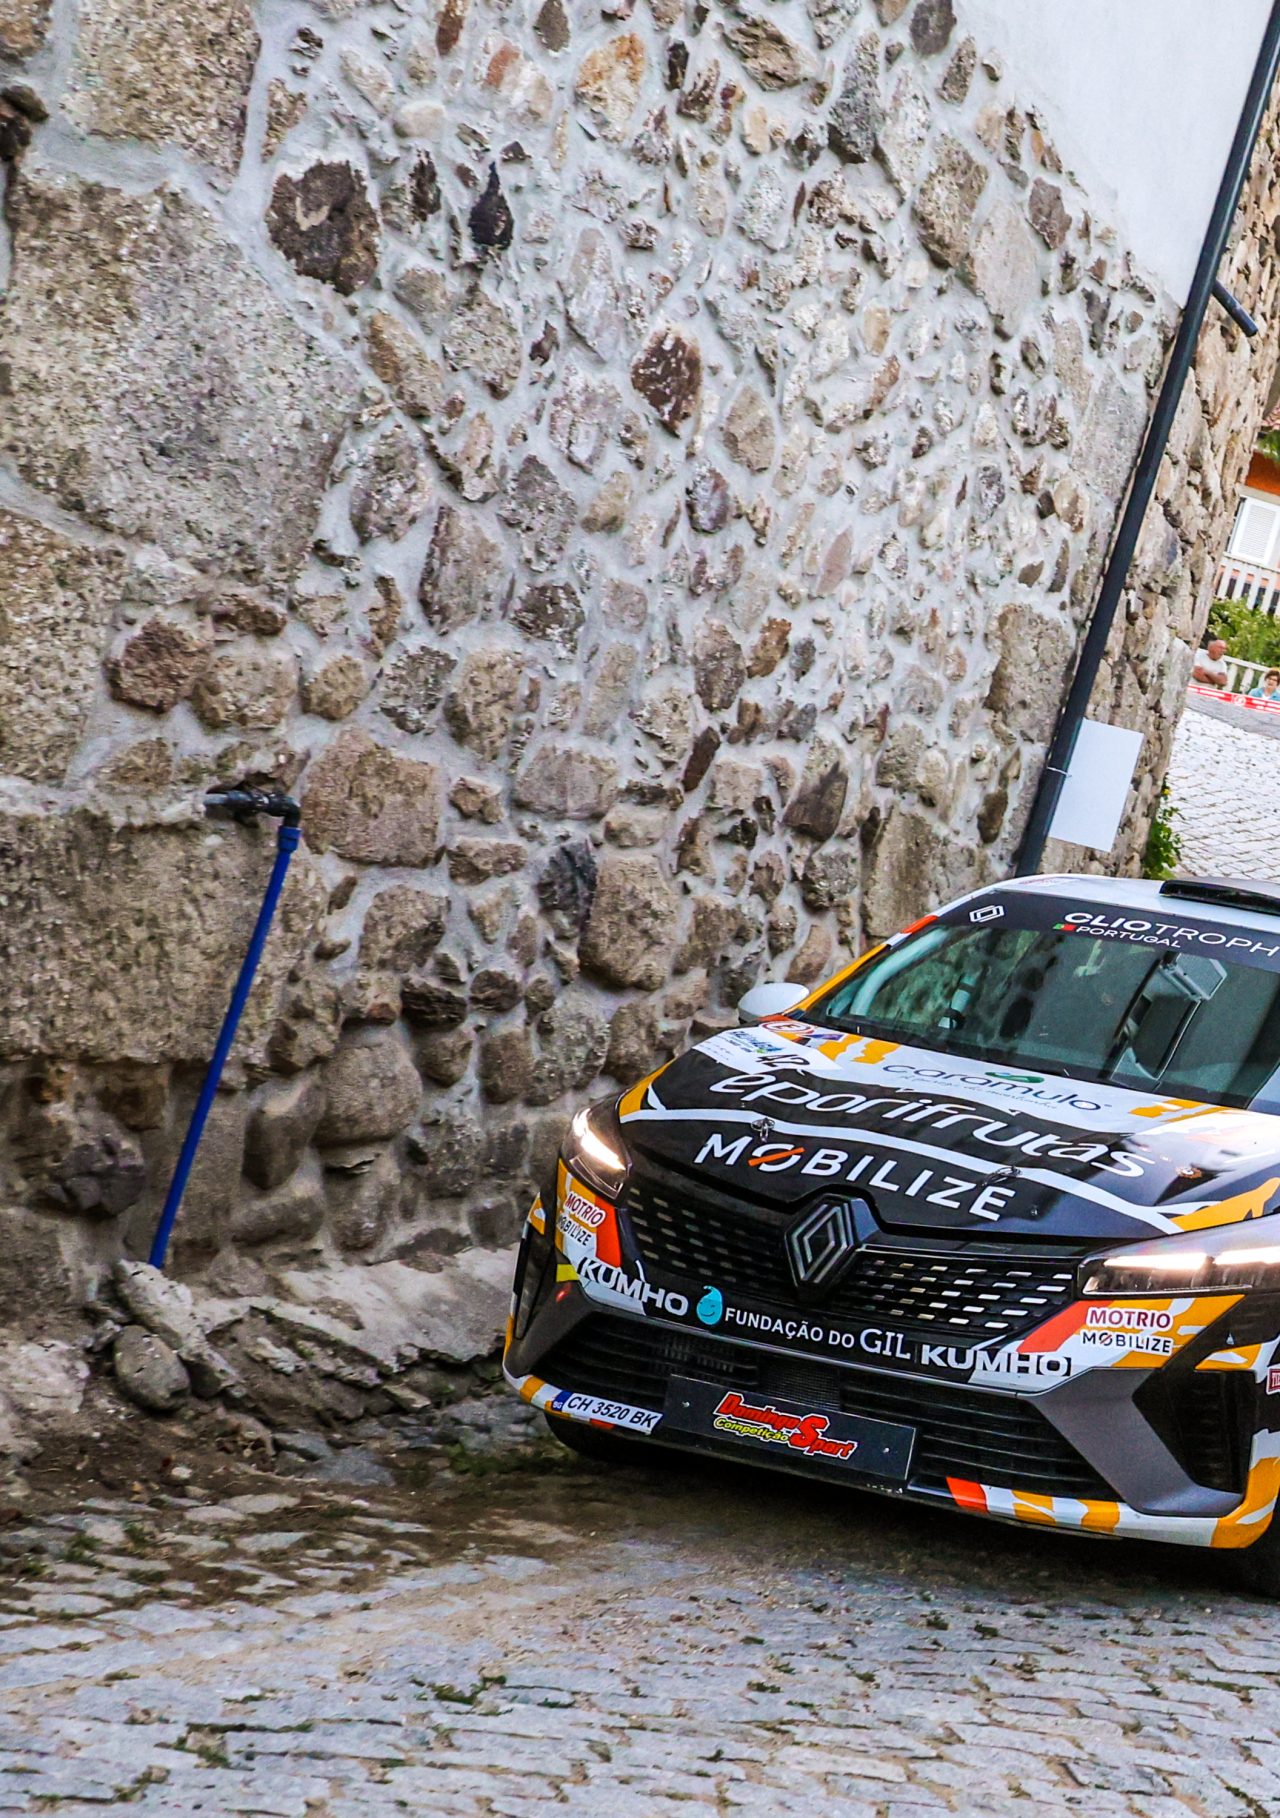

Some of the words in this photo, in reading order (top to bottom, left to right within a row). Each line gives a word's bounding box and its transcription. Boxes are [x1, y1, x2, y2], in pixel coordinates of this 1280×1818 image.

[1076, 926, 1182, 949] PORTUGAL
[756, 1054, 811, 1069] 42
[882, 1064, 1102, 1111] caramulo
[709, 1073, 1155, 1179] eporifrutas
[565, 1193, 604, 1225] MOTRIO
[580, 1256, 689, 1317] KUMHO
[724, 1306, 823, 1342] FUNDAÇÃO
[829, 1330, 855, 1349] DO
[859, 1328, 911, 1360] GIL
[1089, 1309, 1171, 1329] MOTRIO
[921, 1344, 1070, 1378] KUMHO
[567, 1396, 593, 1412] CH
[592, 1402, 631, 1420] 3520
[629, 1411, 659, 1428] BK
[714, 1417, 790, 1442] Competição
